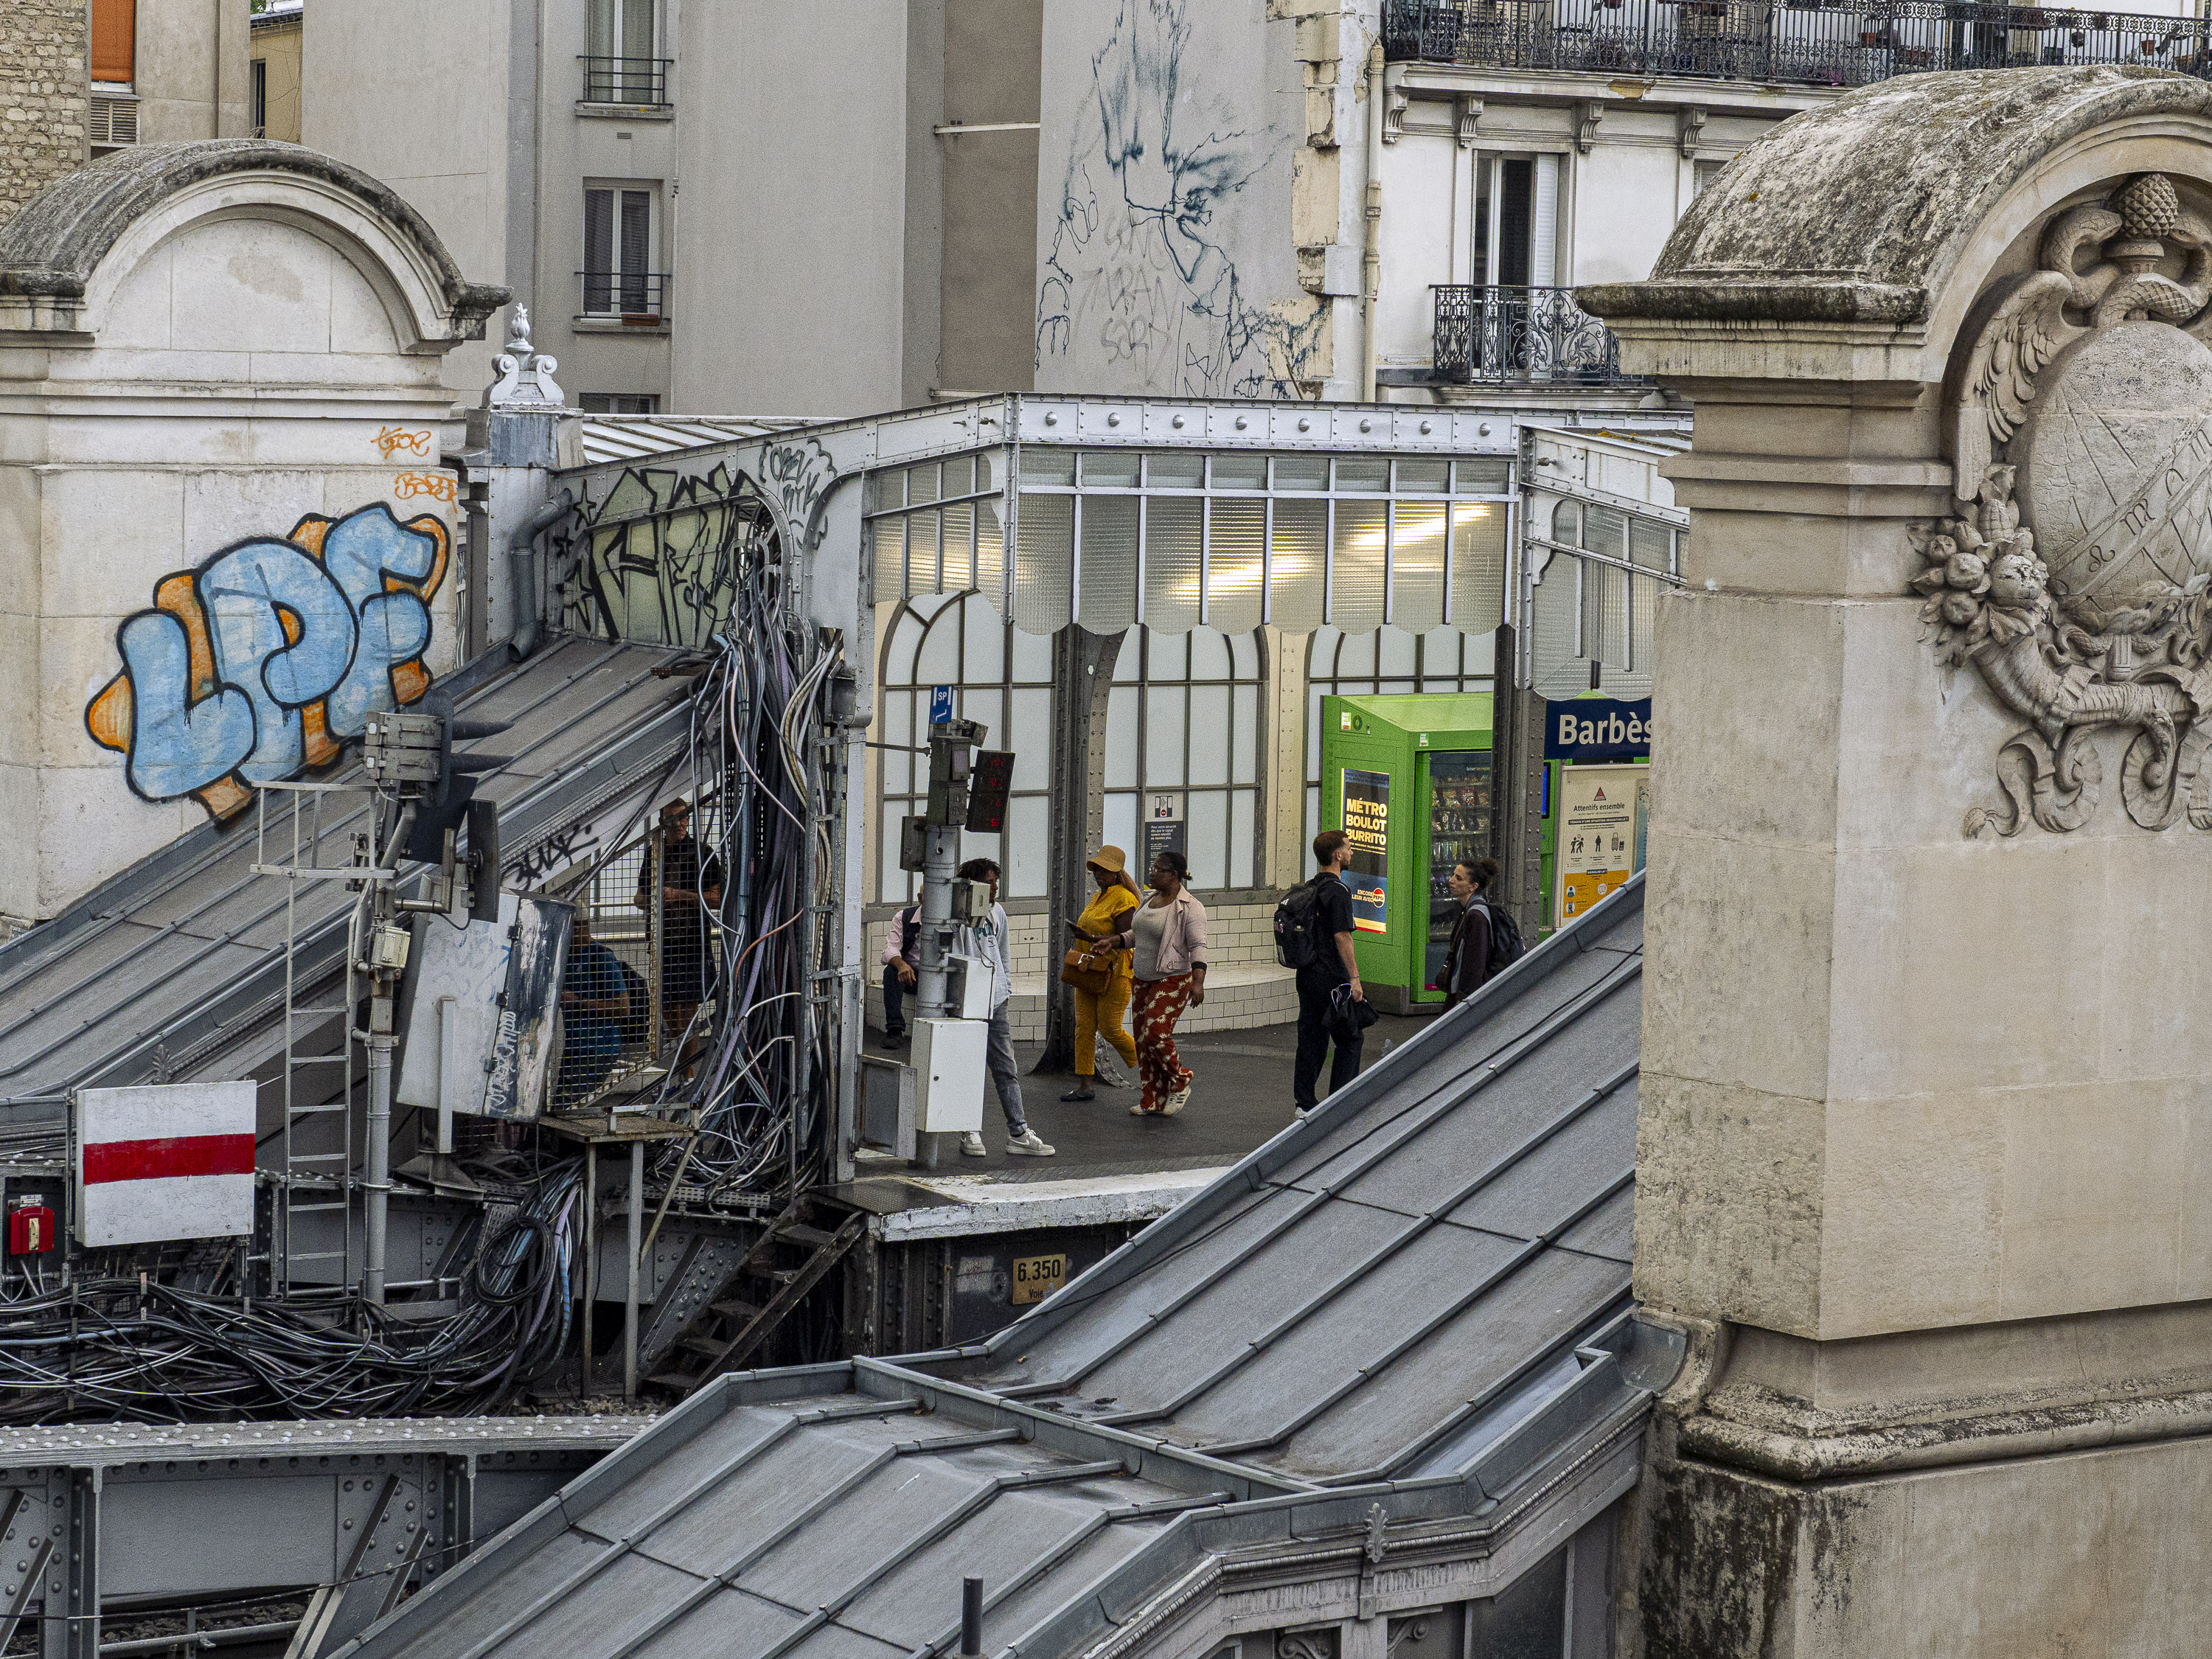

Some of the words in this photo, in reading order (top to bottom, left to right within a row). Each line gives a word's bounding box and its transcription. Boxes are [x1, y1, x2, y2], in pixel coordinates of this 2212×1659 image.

[938, 691, 947, 701] SP
[1559, 712, 1652, 745] Barbès
[1346, 798, 1388, 818] MÉTRO
[1573, 804, 1599, 812] Attentifs
[1599, 802, 1625, 810] ensemble
[1346, 813, 1387, 832] BOULOT
[1346, 828, 1387, 846] BURRITO
[1018, 1259, 1060, 1282] 6.350
[1029, 1288, 1044, 1299] Voie
